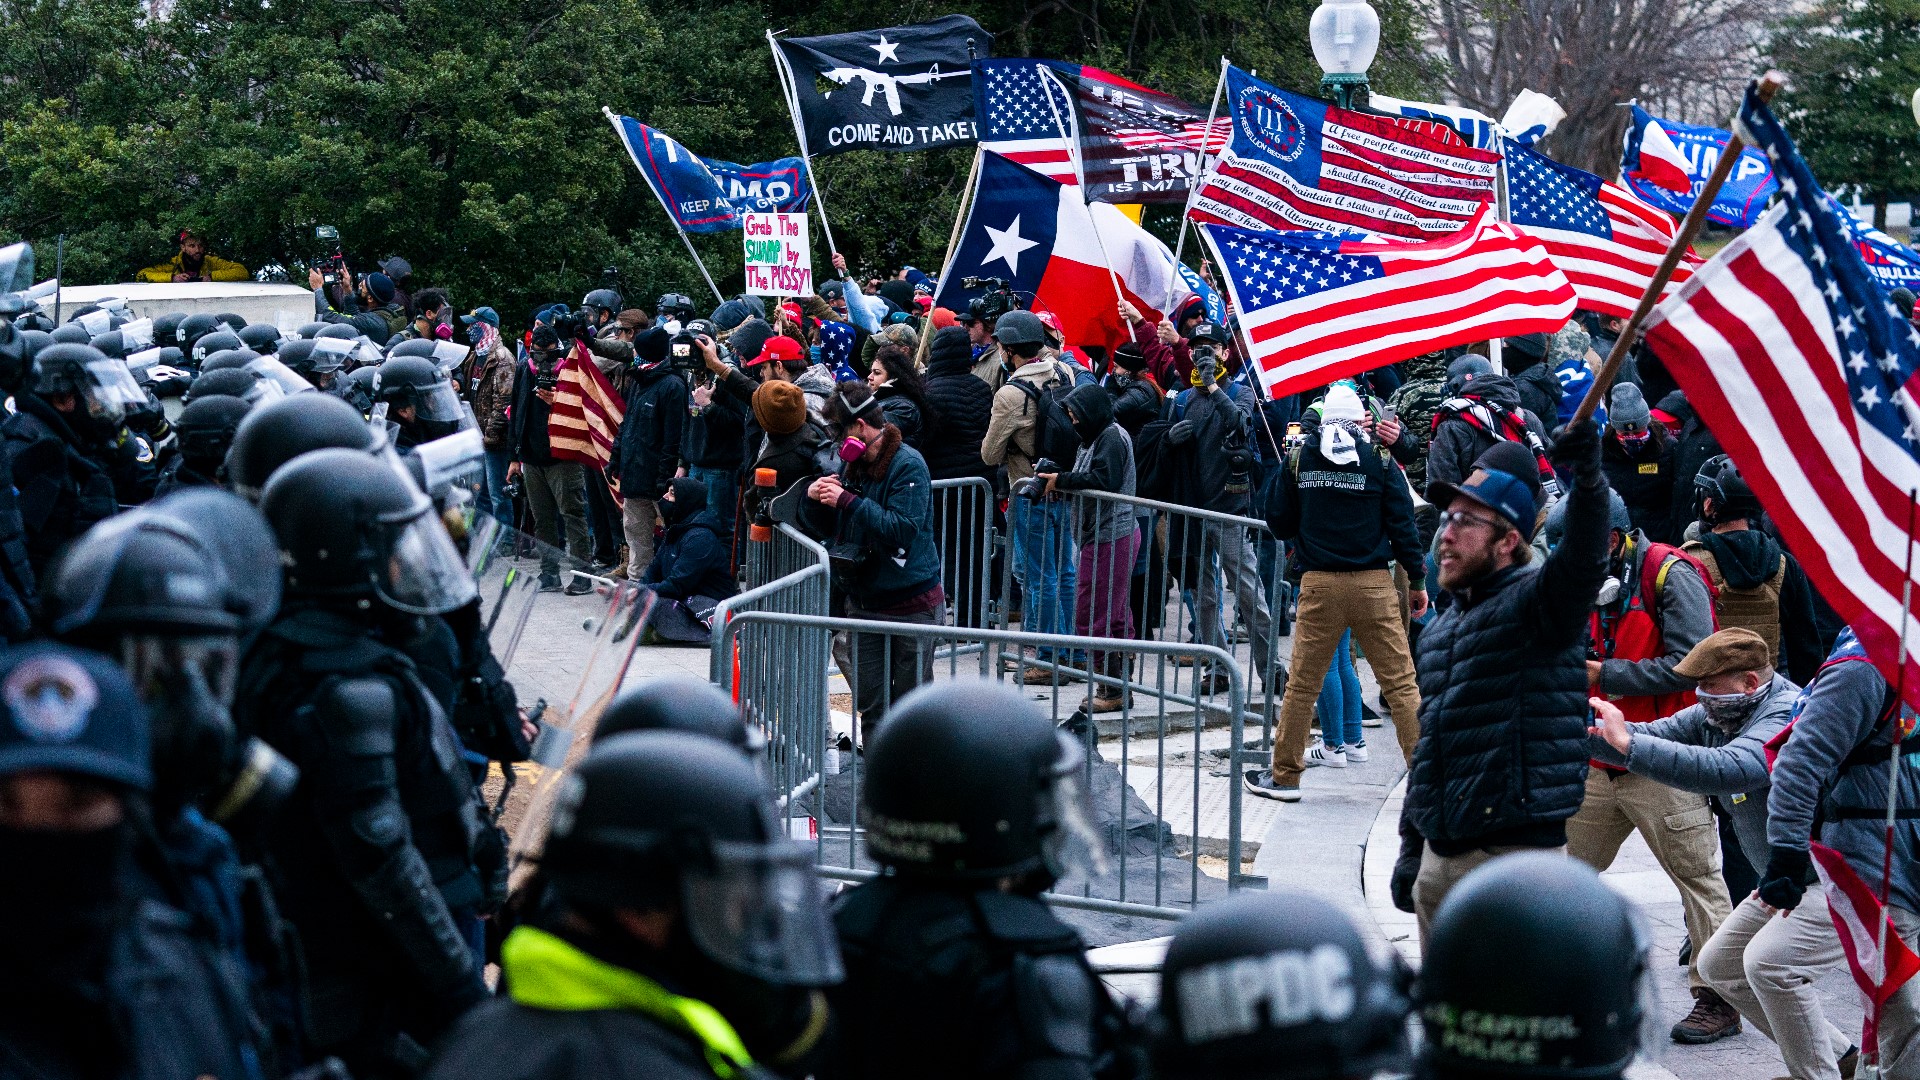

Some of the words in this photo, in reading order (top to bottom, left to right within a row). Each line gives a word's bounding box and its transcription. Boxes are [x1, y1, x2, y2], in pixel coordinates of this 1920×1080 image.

[1256, 105, 1283, 132] III
[828, 123, 881, 146] COME
[882, 124, 914, 145] AND
[917, 121, 970, 144] TAKE
[971, 121, 978, 139] I
[1241, 117, 1267, 151] REBELLION
[1291, 140, 1305, 159] DUTY
[1329, 124, 1339, 134] A
[1341, 129, 1361, 139] free
[1363, 137, 1398, 152] people
[1400, 149, 1431, 161] ought
[1433, 156, 1450, 165] not
[1452, 161, 1476, 173] only
[1478, 163, 1492, 173] Be
[1110, 152, 1217, 183] TRU
[1108, 183, 1133, 193] IS
[1142, 178, 1175, 192] MY
[1282, 175, 1290, 184] to
[1291, 183, 1332, 204] maintain
[1346, 201, 1375, 213] status
[1378, 208, 1391, 219] of
[1327, 167, 1360, 182] should
[1361, 175, 1386, 189] have
[1388, 185, 1437, 207] sufficient
[1440, 202, 1464, 212] arms
[680, 199, 709, 214] KEEP
[1197, 199, 1234, 218] include
[1235, 214, 1263, 230] Their
[1212, 178, 1231, 189] any
[1233, 186, 1254, 196] who
[1254, 193, 1285, 211] might
[1284, 207, 1324, 229] Attempt
[1326, 223, 1336, 232] to
[746, 215, 773, 236] Grab
[777, 215, 799, 237] The
[786, 242, 800, 267] by
[746, 266, 769, 290] The
[771, 265, 811, 295] PUSSY!
[1298, 480, 1324, 489] NSTITUTE
[1334, 481, 1365, 491] CANNABIS
[1299, 470, 1367, 484] ORTHEASTERN
